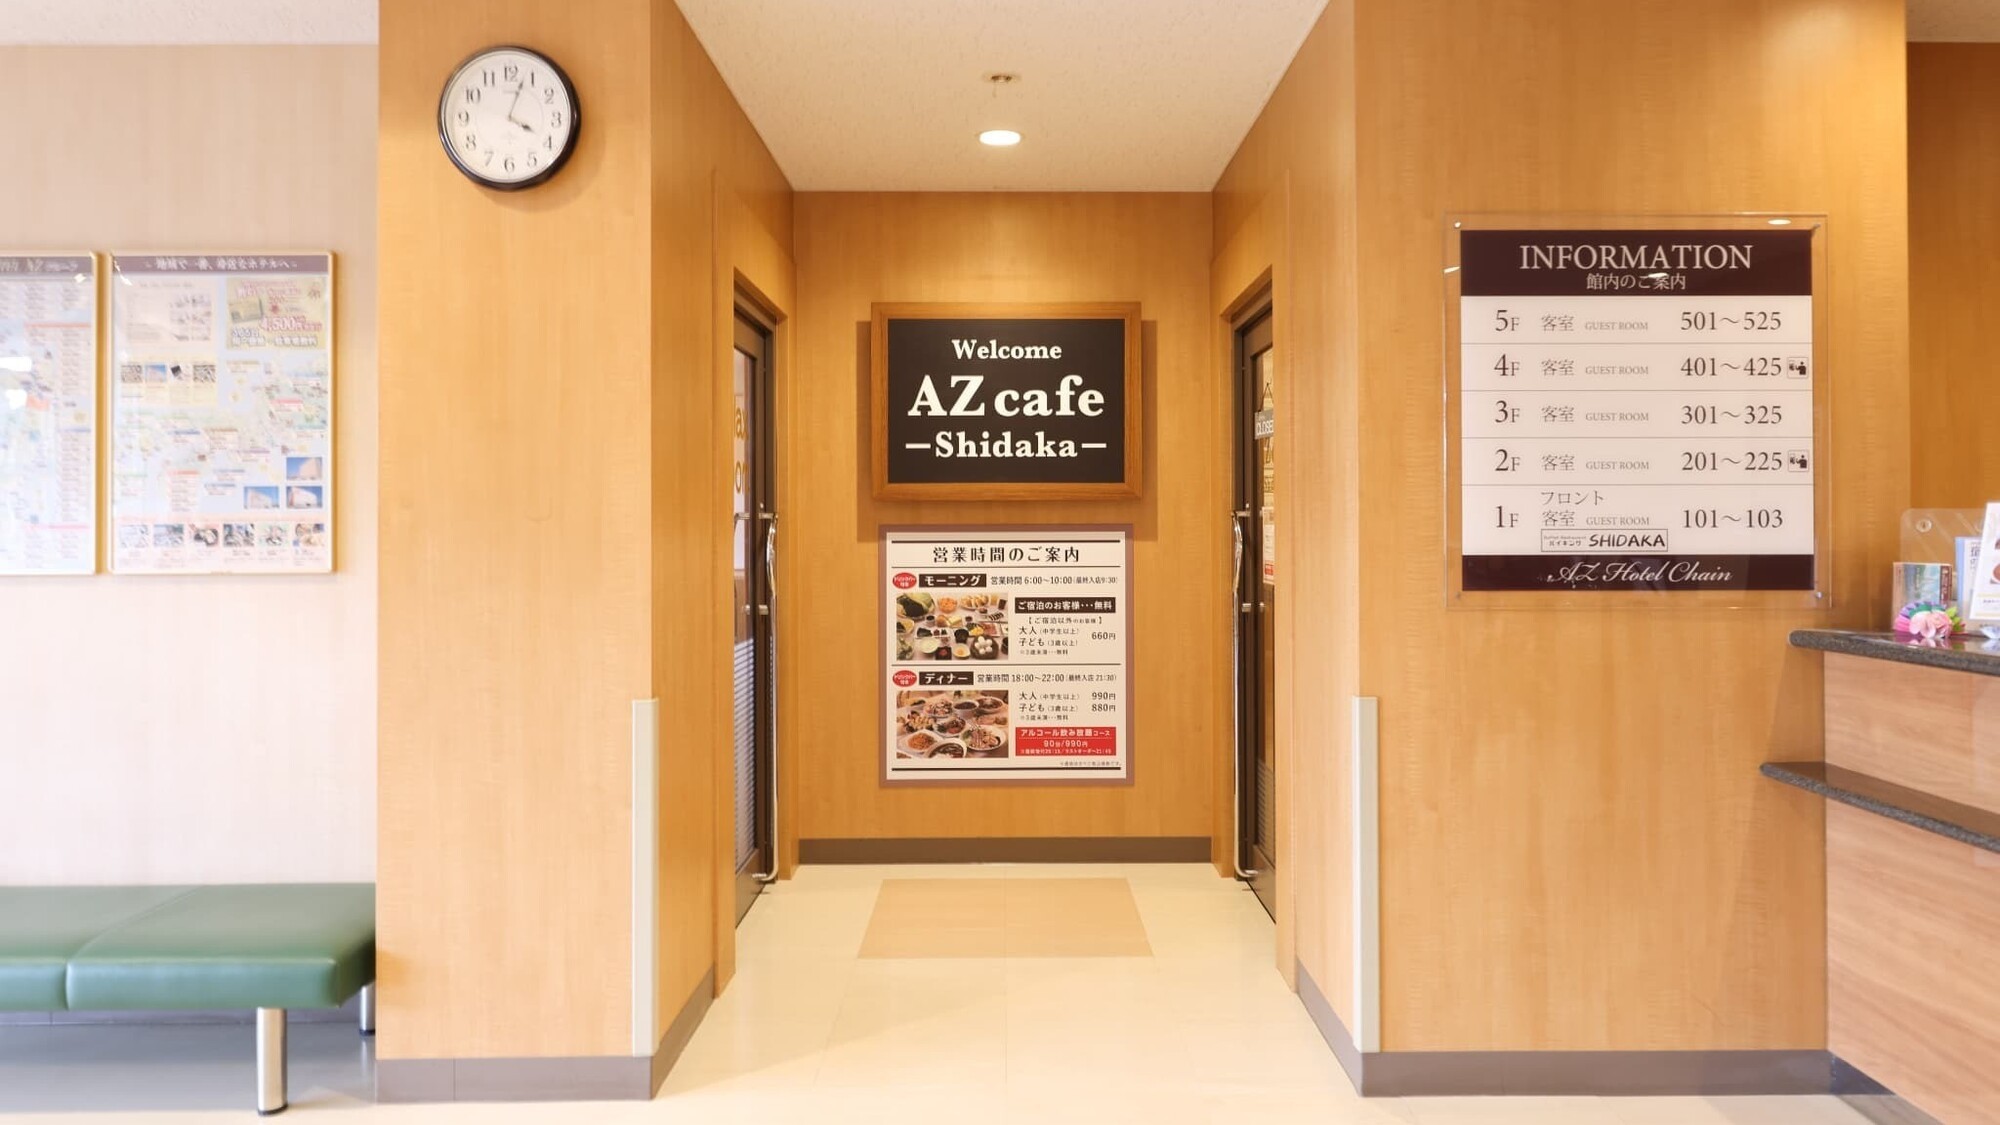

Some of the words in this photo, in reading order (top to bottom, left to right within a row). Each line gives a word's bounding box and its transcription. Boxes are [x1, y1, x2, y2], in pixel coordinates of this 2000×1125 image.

[483, 69, 495, 87] 11
[504, 64, 519, 81] 12
[466, 87, 481, 103] 10
[544, 88, 554, 104] 2
[458, 110, 469, 126] 9
[551, 112, 561, 128] 3
[466, 134, 476, 150] 8
[543, 135, 552, 151] 4
[484, 150, 494, 166] 7
[504, 157, 515, 172] 6
[527, 152, 537, 167] 5
[1520, 245, 1753, 270] INFORMATION
[1586, 273, 1686, 290] 館内のご案内
[1495, 309, 1520, 332] 5F
[1541, 314, 1574, 332] 客室
[1585, 321, 1615, 330] GUEST
[1616, 321, 1648, 330] ROOM
[951, 339, 1062, 359] Welcome
[1494, 354, 1520, 377] 4F
[1541, 359, 1575, 377] 客室
[1585, 366, 1616, 375] GUEST
[1617, 366, 1649, 375] ROOM
[907, 375, 985, 416] AZ
[994, 375, 1104, 417] cafe
[1495, 400, 1520, 423] 3F
[1541, 405, 1575, 423] 客室
[1585, 412, 1616, 421] GUEST
[1617, 412, 1649, 421] ROOM
[1495, 449, 1521, 472] 2F
[1541, 454, 1575, 472] 客室
[1586, 461, 1616, 470] GUEST
[1617, 461, 1650, 470] ROOM
[1541, 490, 1604, 506] フロント
[1495, 506, 1519, 528] 1F
[1542, 510, 1575, 528] 客室
[1586, 516, 1617, 525] GUEST
[1617, 516, 1650, 525] ROOM
[1589, 534, 1666, 547] SHIDAKA
[933, 546, 1079, 563] 営業時間のご案内
[1549, 561, 1601, 583] AZ
[1602, 561, 1670, 582] Hotel
[1668, 561, 1732, 582] Chain
[925, 575, 981, 586] モーニング
[990, 576, 1022, 585] 営業時間
[1091, 631, 1116, 640] 660円
[924, 673, 969, 684] ディナー
[977, 674, 1009, 683] 営業時間
[1091, 691, 1116, 700] 990円
[1091, 703, 1116, 712] 880円
